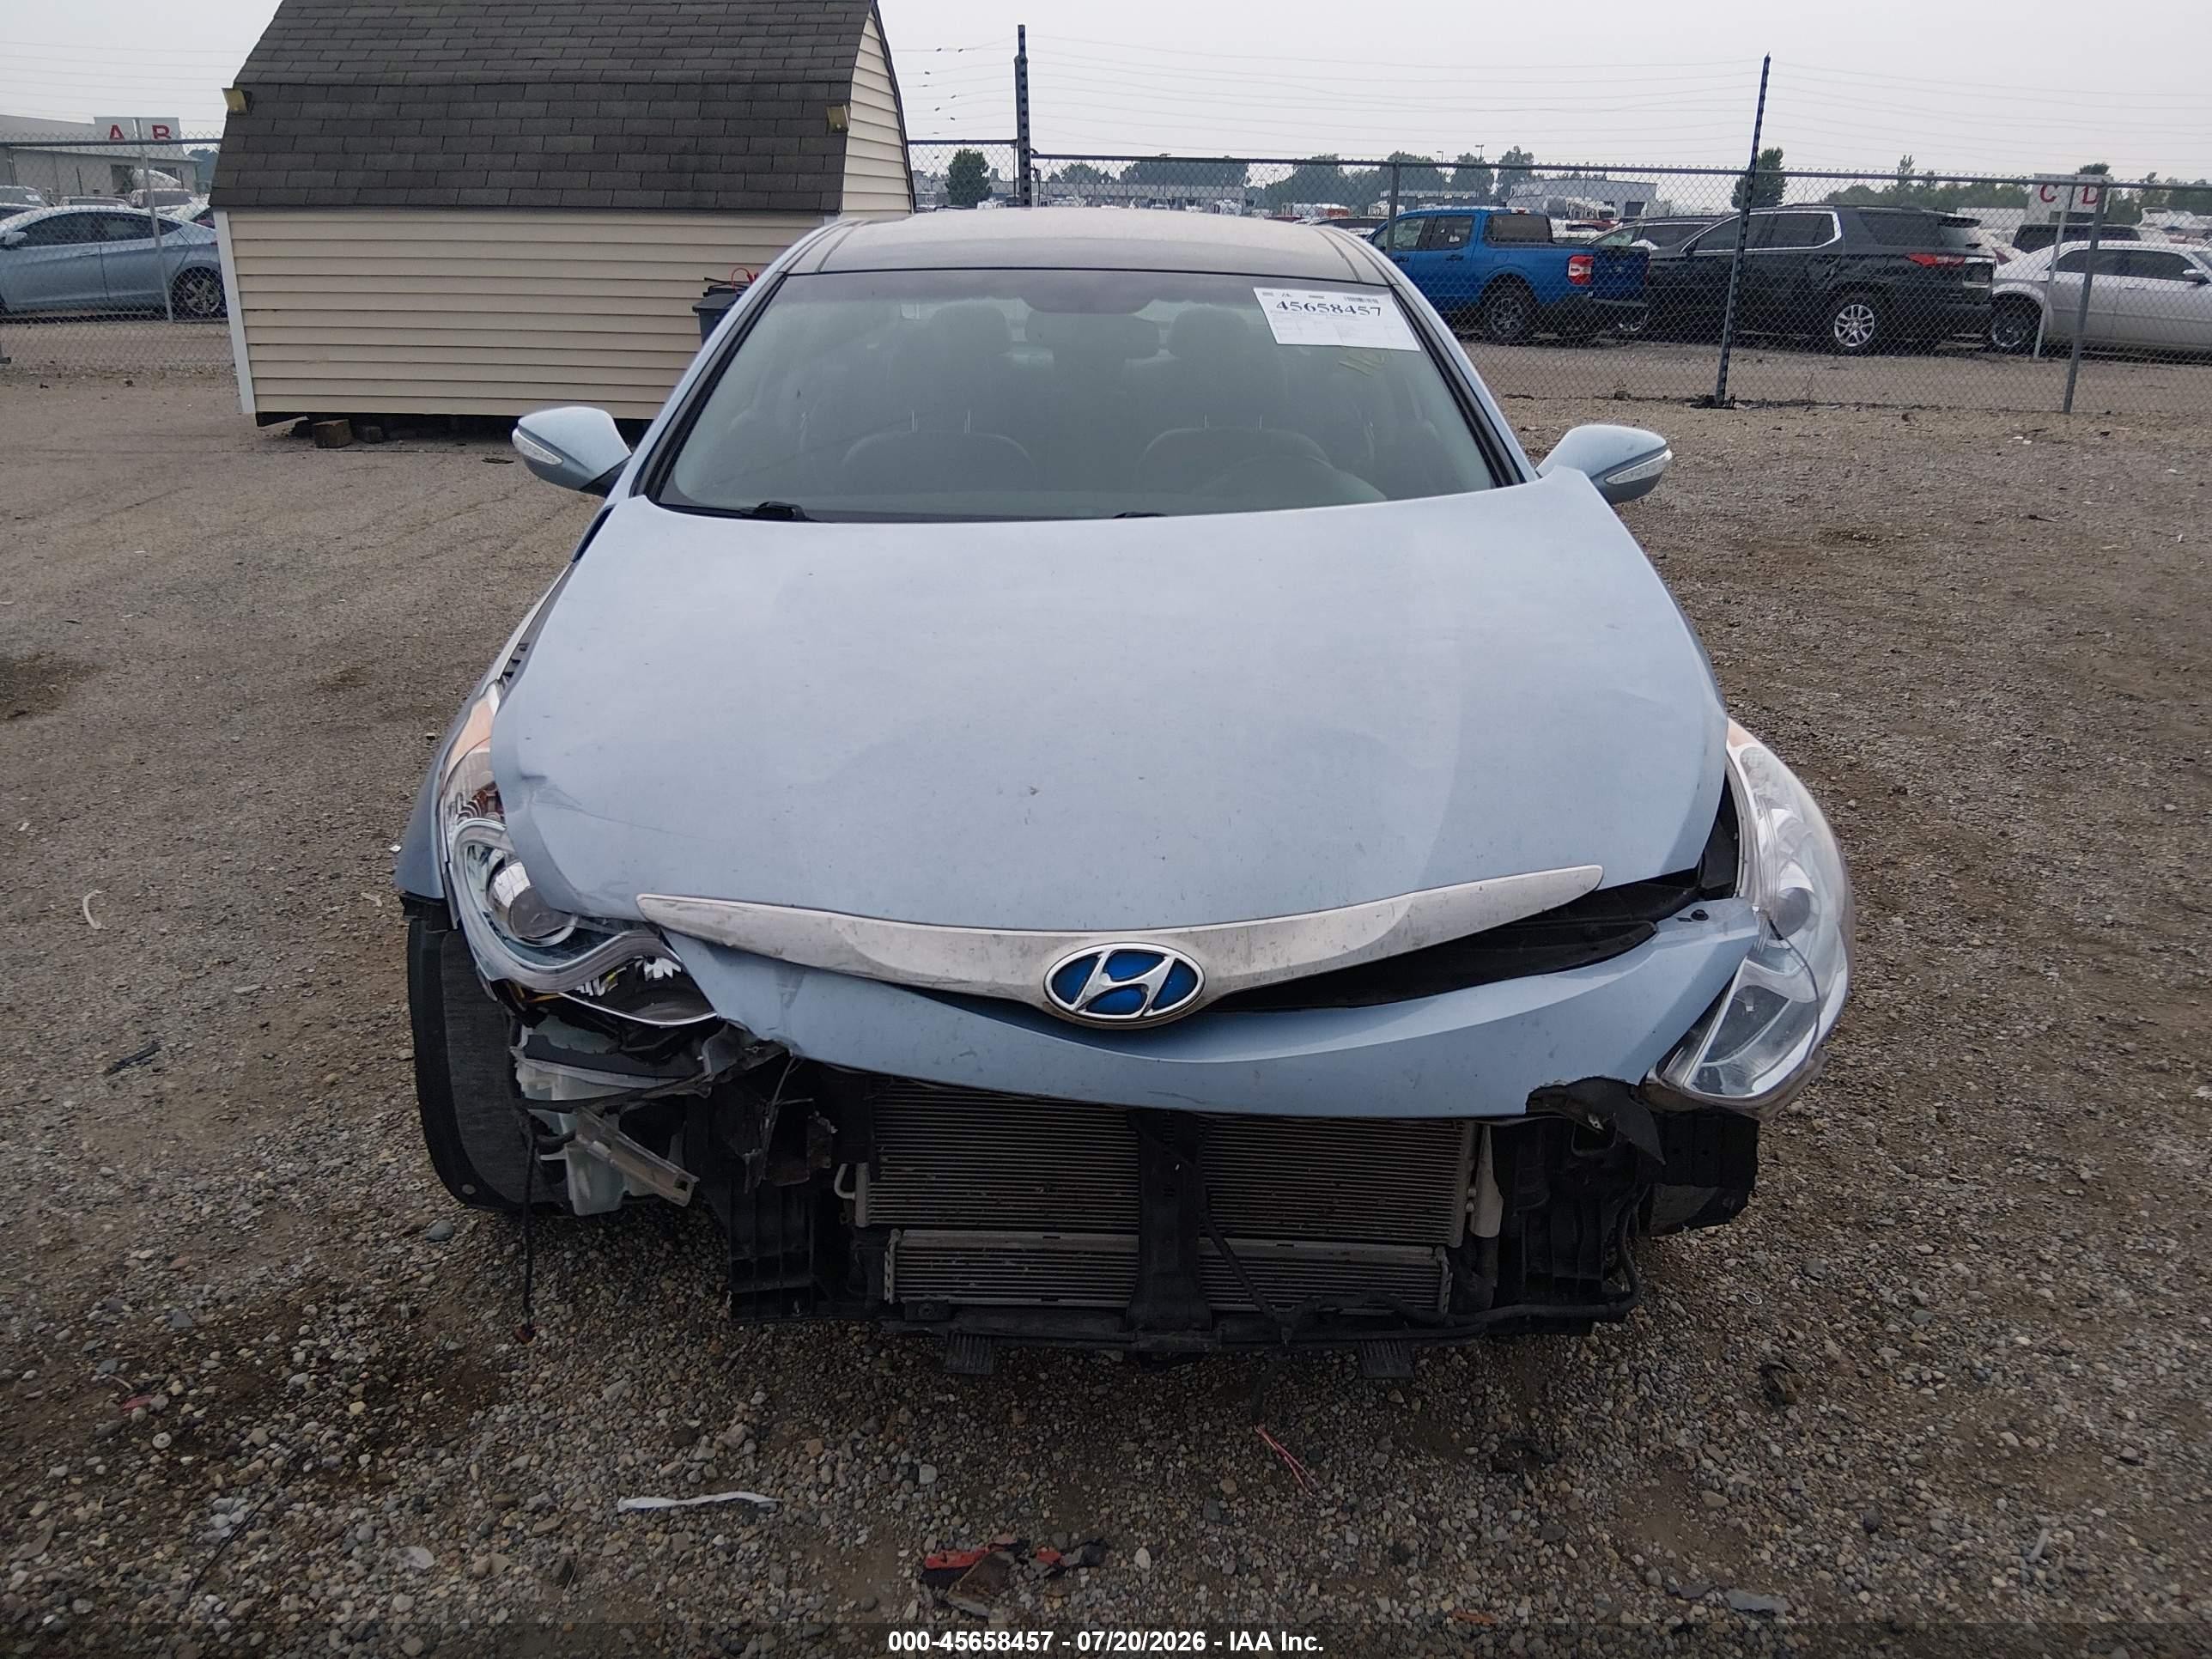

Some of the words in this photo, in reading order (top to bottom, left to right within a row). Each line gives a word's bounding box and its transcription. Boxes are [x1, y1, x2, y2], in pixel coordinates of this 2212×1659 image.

[109, 124, 125, 140] A
[2039, 183, 2058, 203] C
[1276, 301, 1382, 317] 45658457
